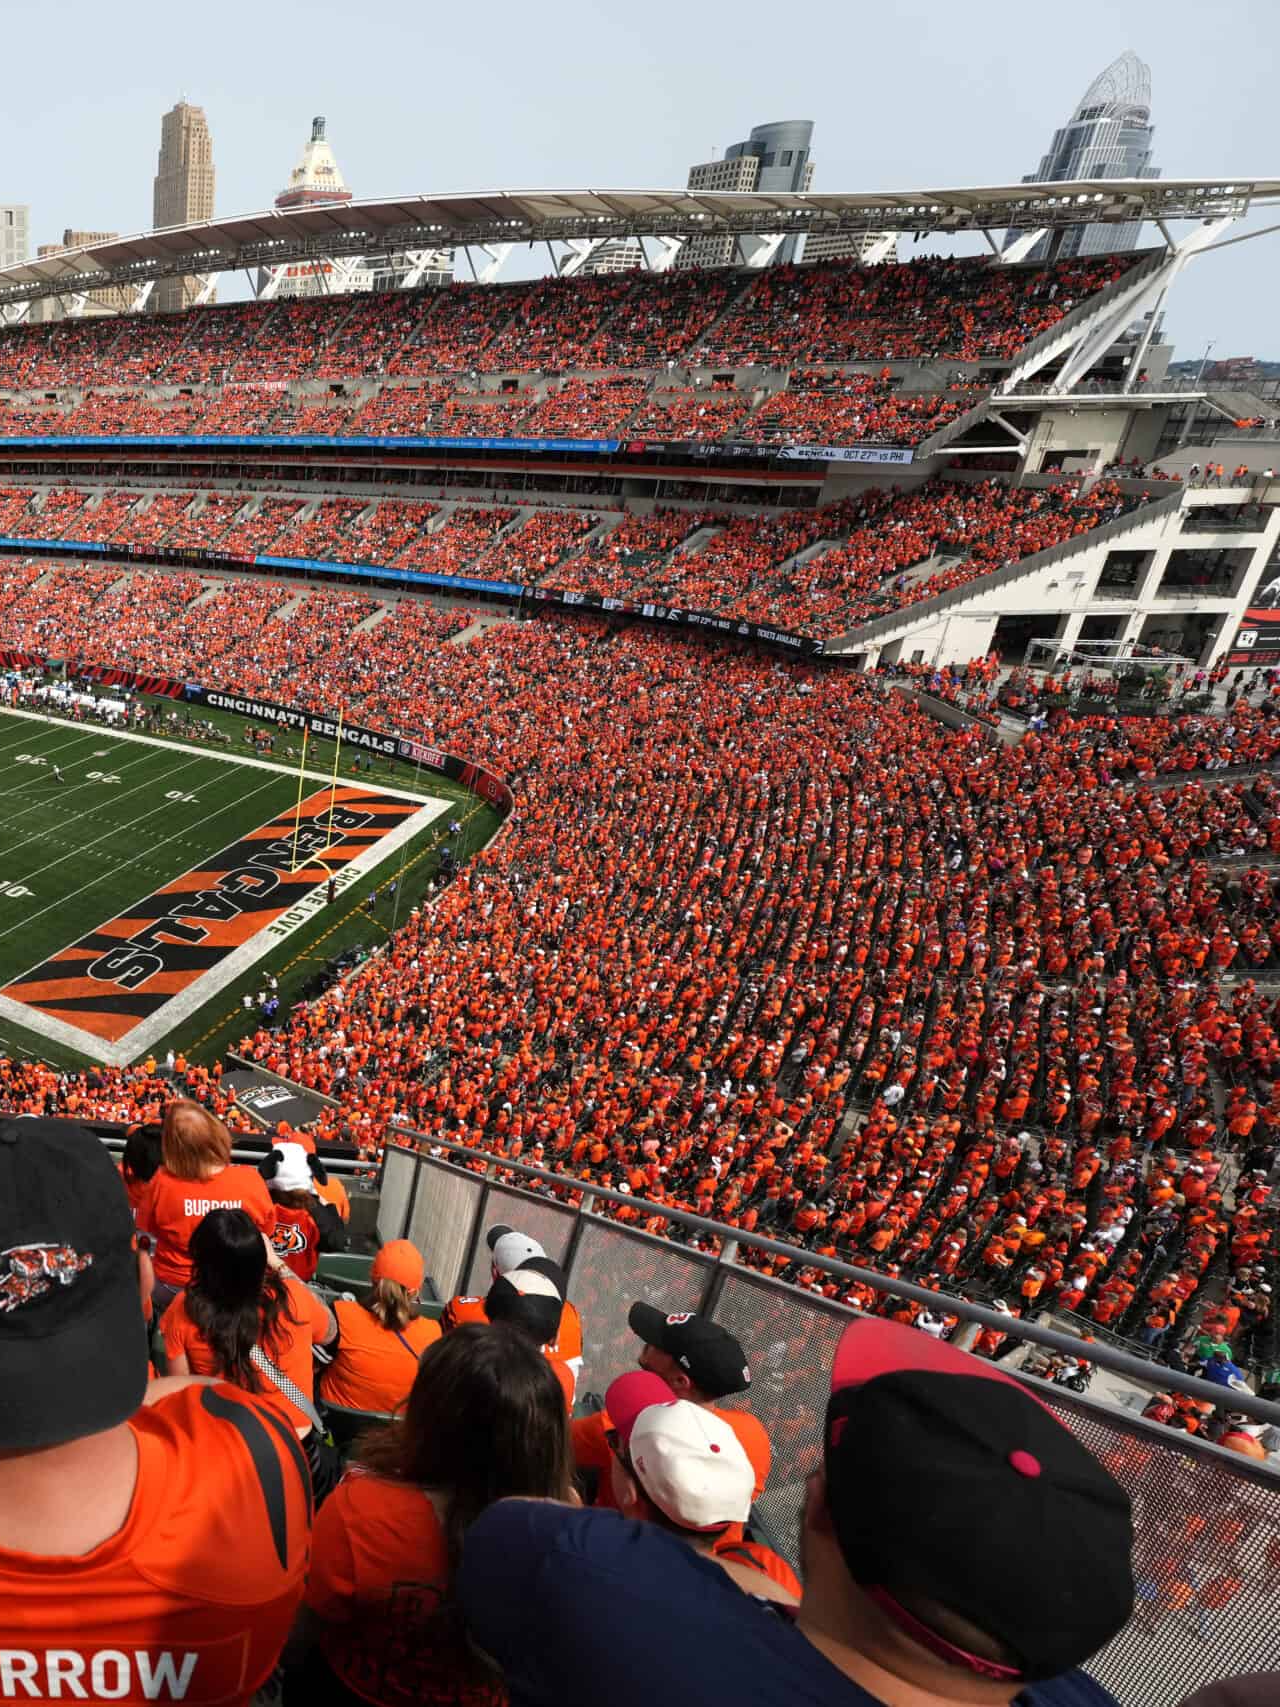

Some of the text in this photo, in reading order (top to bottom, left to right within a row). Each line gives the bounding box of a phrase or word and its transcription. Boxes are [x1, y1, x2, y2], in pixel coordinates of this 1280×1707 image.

[844, 450, 859, 459] OCT
[756, 628, 776, 641] TICKETS
[776, 633, 802, 647] AVAILABLE
[207, 694, 397, 754] CINCINNATI BENGALS
[87, 806, 375, 990] BENGALS
[268, 867, 361, 936] CHOSE LOVE
